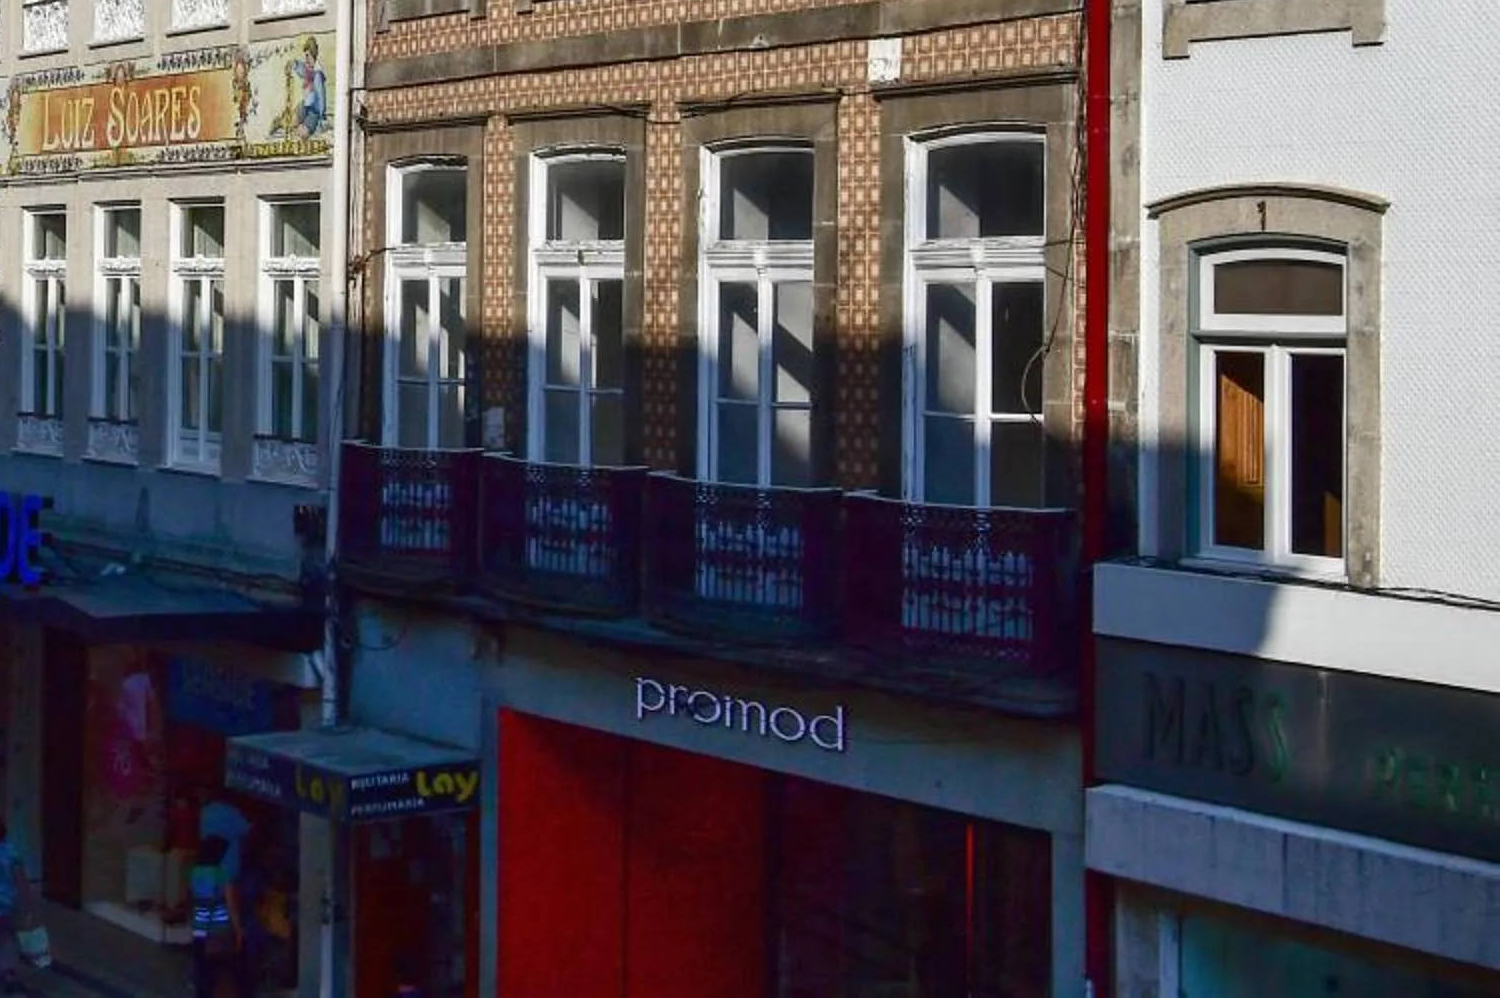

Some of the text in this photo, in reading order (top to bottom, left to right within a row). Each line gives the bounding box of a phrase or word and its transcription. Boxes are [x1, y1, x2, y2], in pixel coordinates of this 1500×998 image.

[42, 85, 202, 151] LUIZ SOARES
[634, 676, 845, 752] promod
